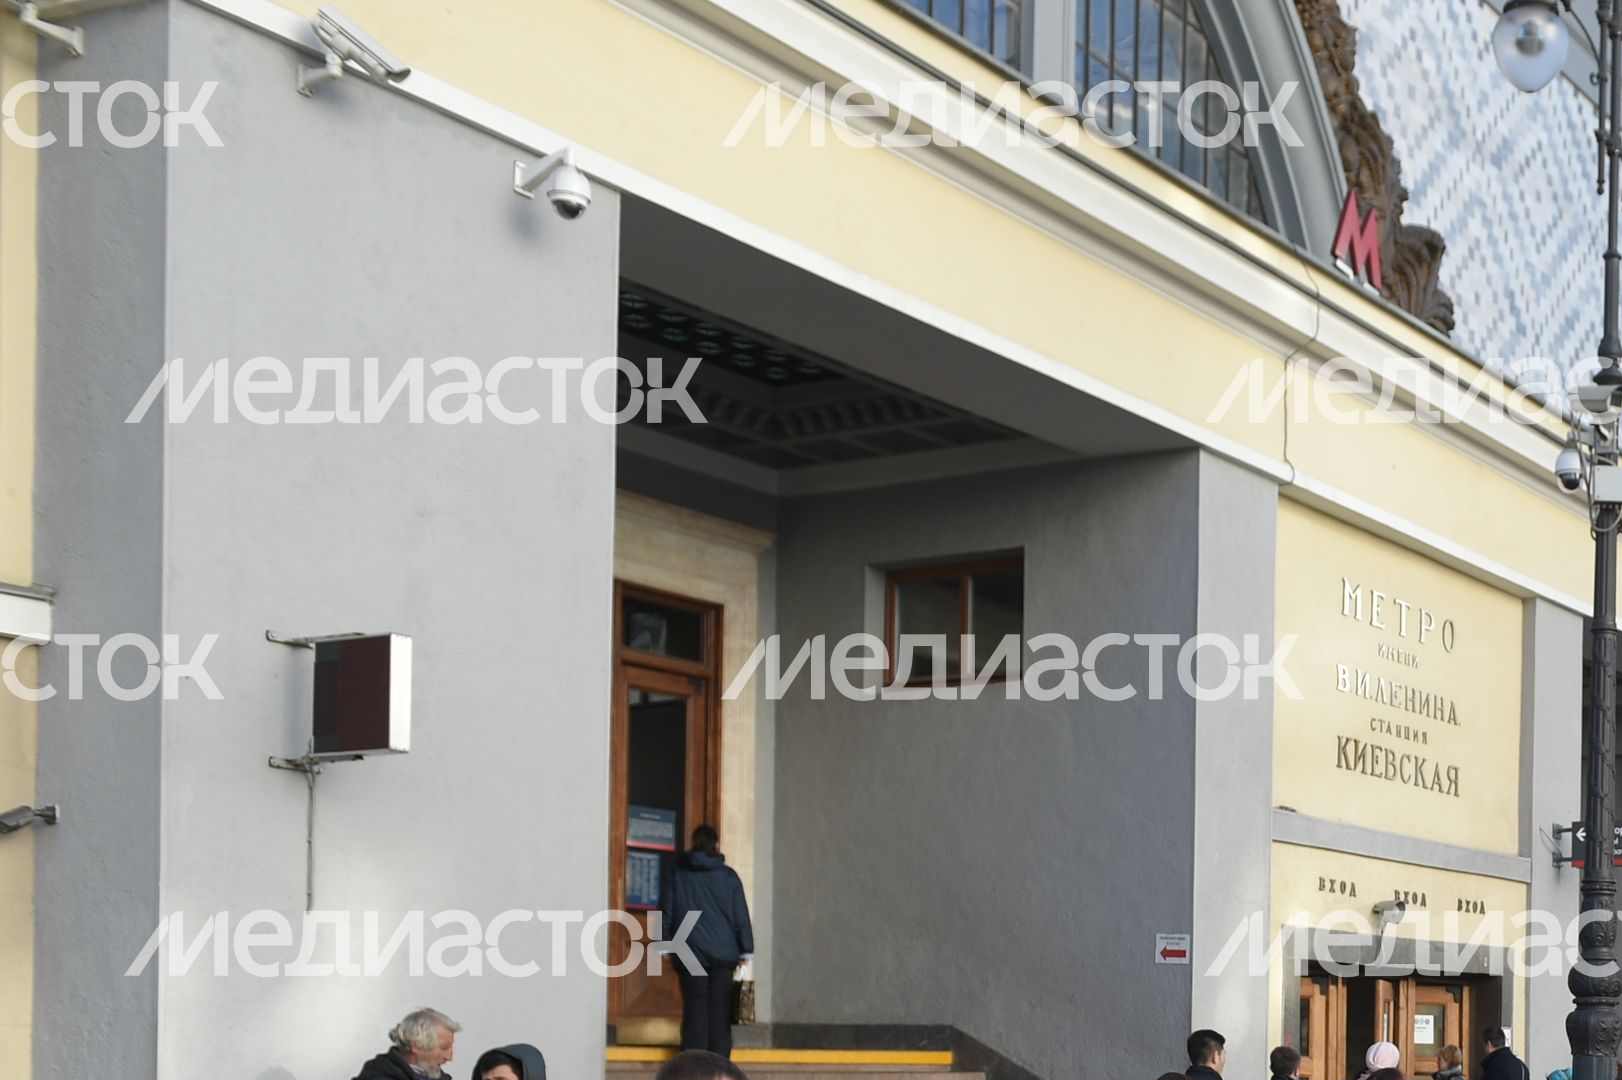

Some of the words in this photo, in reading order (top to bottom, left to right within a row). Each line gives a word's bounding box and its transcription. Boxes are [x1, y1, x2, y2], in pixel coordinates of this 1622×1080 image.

[1342, 576, 1455, 653] МЕТРО
[1369, 718, 1428, 745] СТАНЦИЯ
[1336, 735, 1460, 797] КИЕВСКАЯ
[1318, 876, 1357, 898] ВХОД
[1394, 889, 1427, 907] ВХОД
[1457, 898, 1486, 915] ВХОД
